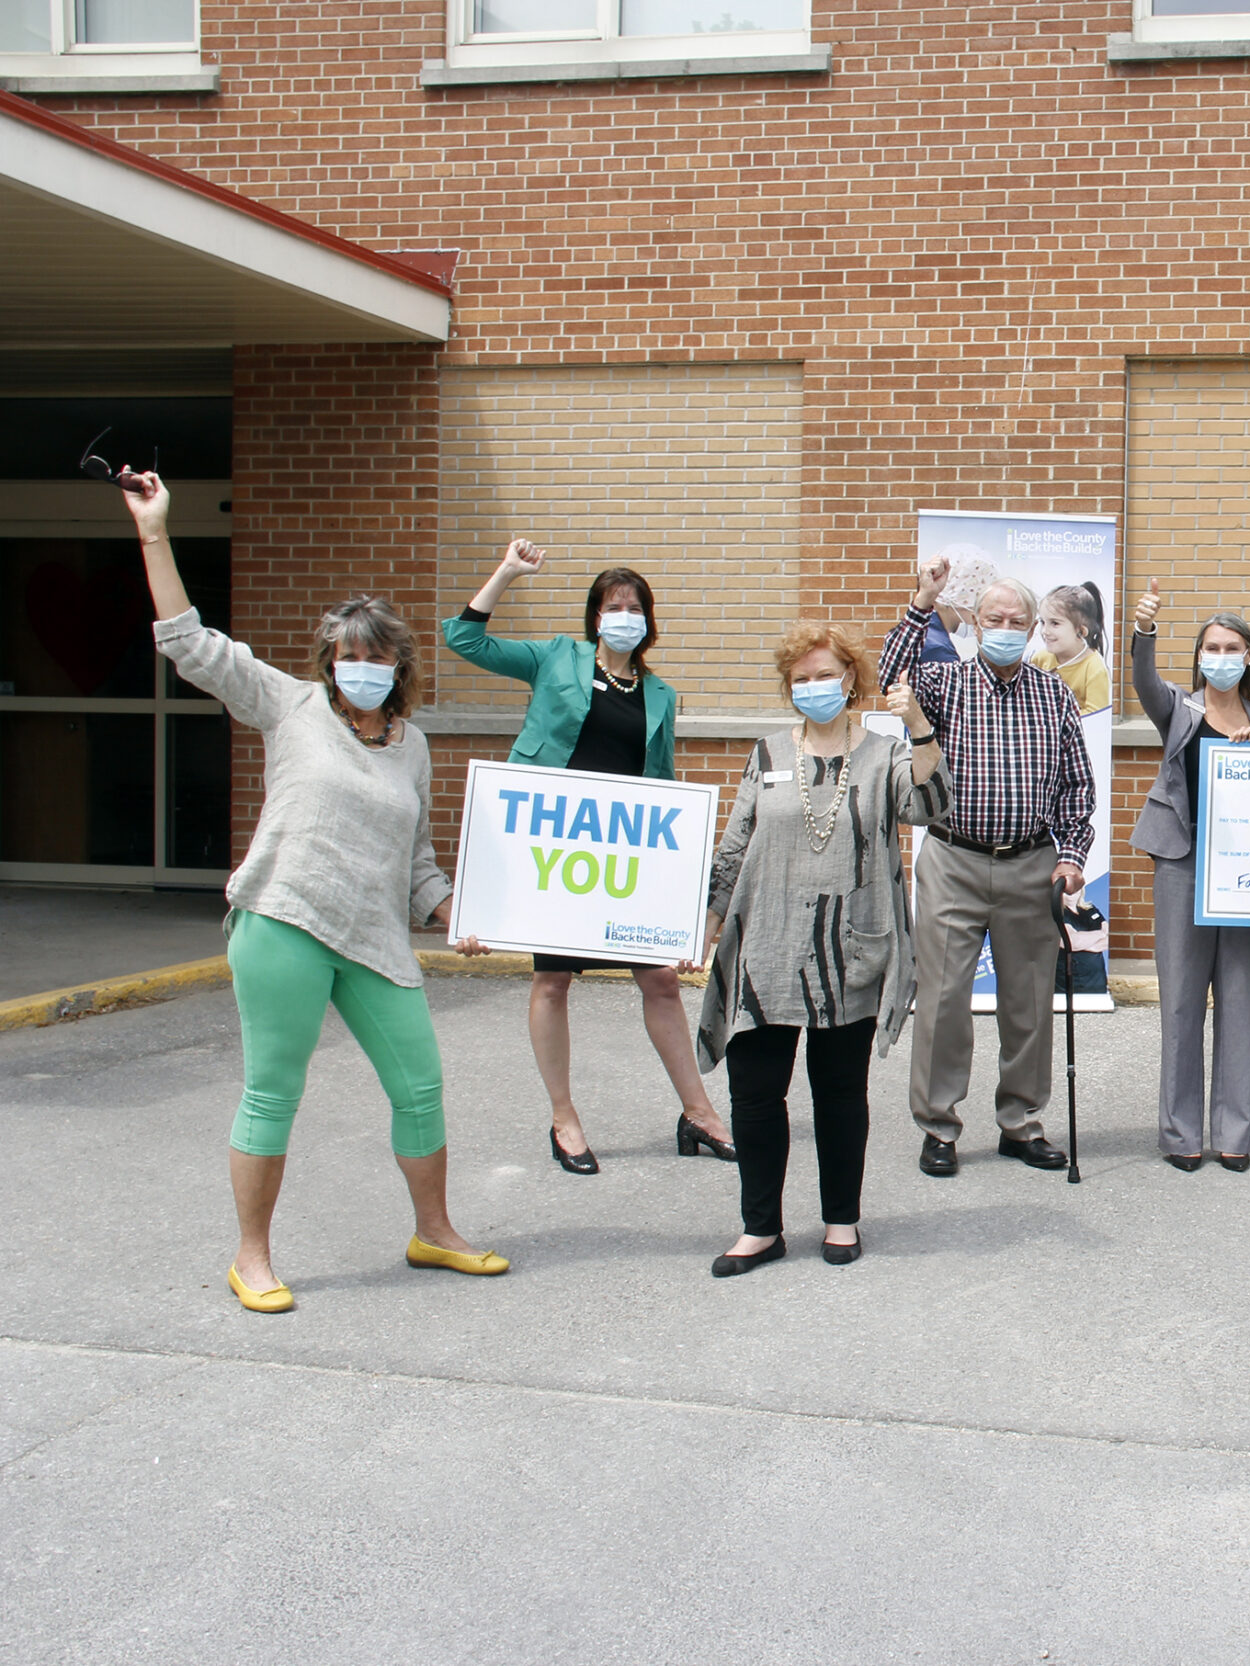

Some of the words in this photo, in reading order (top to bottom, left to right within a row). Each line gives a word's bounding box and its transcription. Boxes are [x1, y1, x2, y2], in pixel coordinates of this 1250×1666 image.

[1014, 529, 1041, 541] Love
[1043, 531, 1062, 542] the
[1063, 531, 1106, 546] County
[1014, 540, 1041, 552] Back
[1043, 541, 1061, 552] the
[1063, 542, 1092, 554] Build
[499, 789, 683, 850] THANK
[530, 846, 639, 899] YOU
[611, 931, 635, 942] Back
[636, 935, 653, 944] the
[653, 936, 679, 947] Build
[612, 922, 636, 932] Love
[637, 925, 654, 935] the
[654, 926, 691, 940] County
